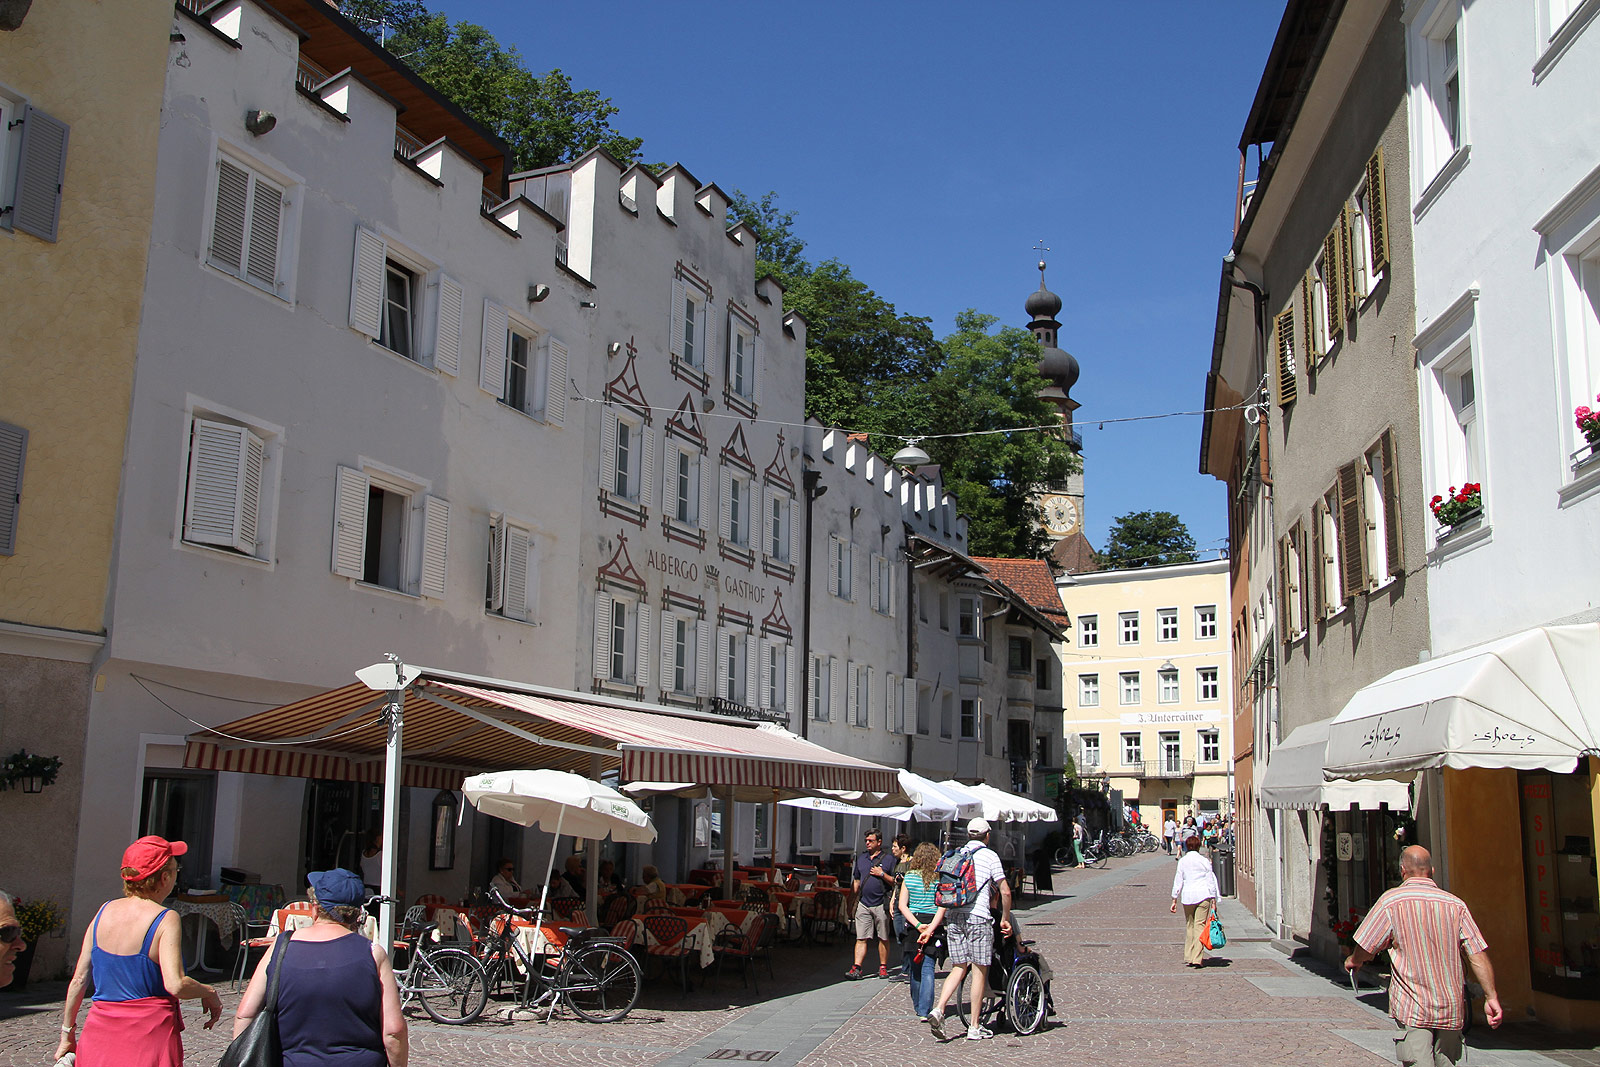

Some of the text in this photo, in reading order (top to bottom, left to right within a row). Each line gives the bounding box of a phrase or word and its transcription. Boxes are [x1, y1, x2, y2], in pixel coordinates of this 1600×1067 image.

[647, 549, 765, 604] ALBERGO GASTHOF
[1148, 712, 1204, 723] Unterrainer
[1360, 716, 1401, 758] shoes
[1472, 726, 1535, 748] shoes
[1534, 815, 1551, 934] SUPER
